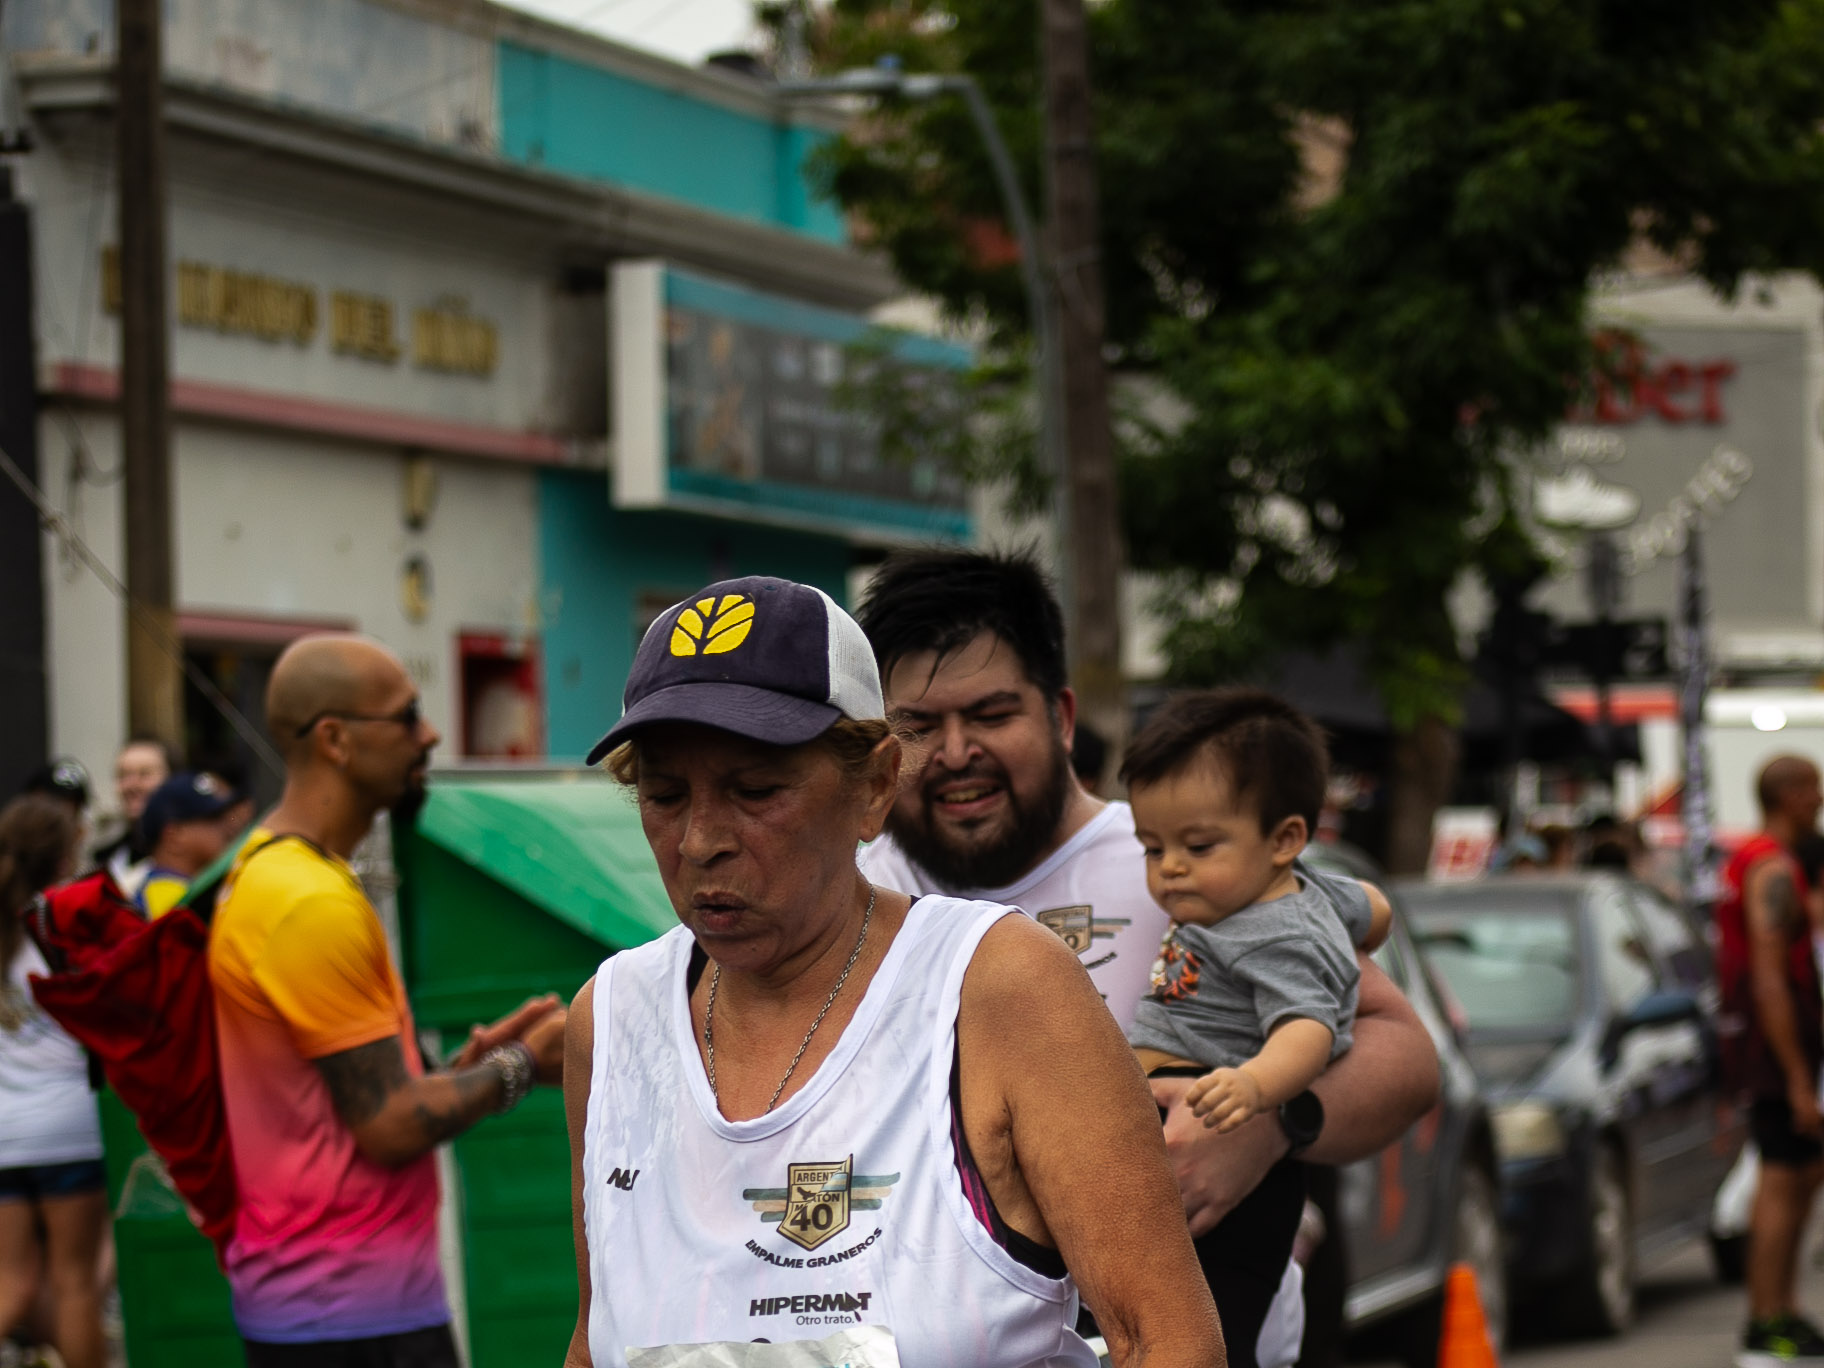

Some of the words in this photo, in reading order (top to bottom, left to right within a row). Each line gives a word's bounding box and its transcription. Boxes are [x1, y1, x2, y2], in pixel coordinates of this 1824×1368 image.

[790, 1204, 833, 1231] 40
[745, 1239, 804, 1268] EMPALME
[806, 1227, 882, 1268] GRANEROS
[796, 1315, 821, 1325] Otro
[824, 1315, 854, 1325] trato.
